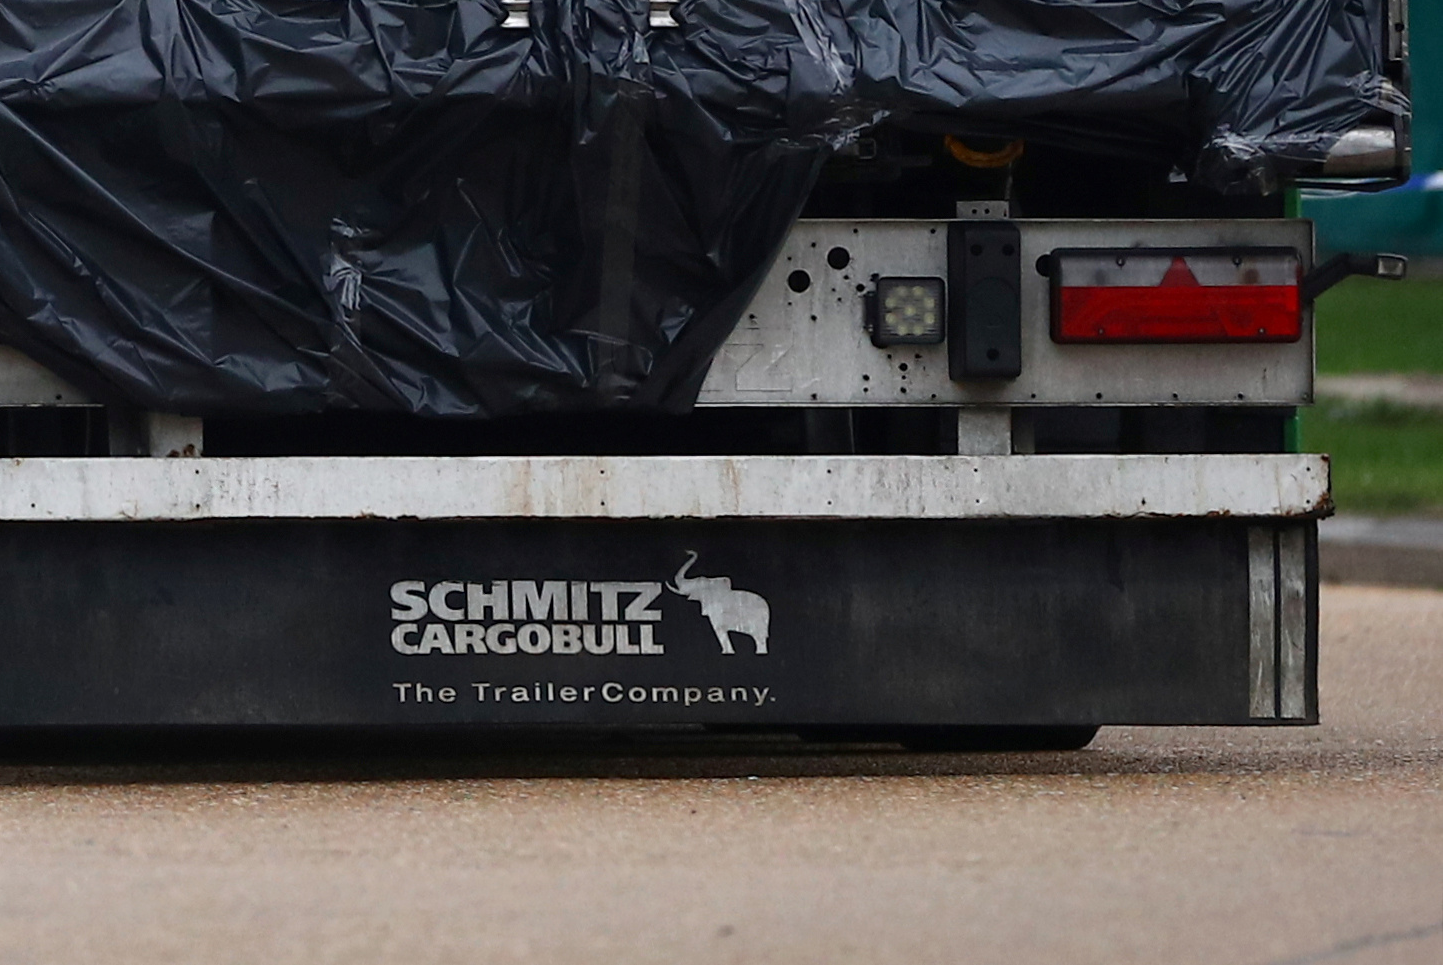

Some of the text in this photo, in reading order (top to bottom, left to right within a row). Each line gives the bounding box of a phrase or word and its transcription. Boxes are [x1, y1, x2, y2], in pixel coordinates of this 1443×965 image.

[391, 581, 661, 621] SCHMITZ
[392, 624, 664, 654] CARGOBULL
[393, 683, 456, 702] The
